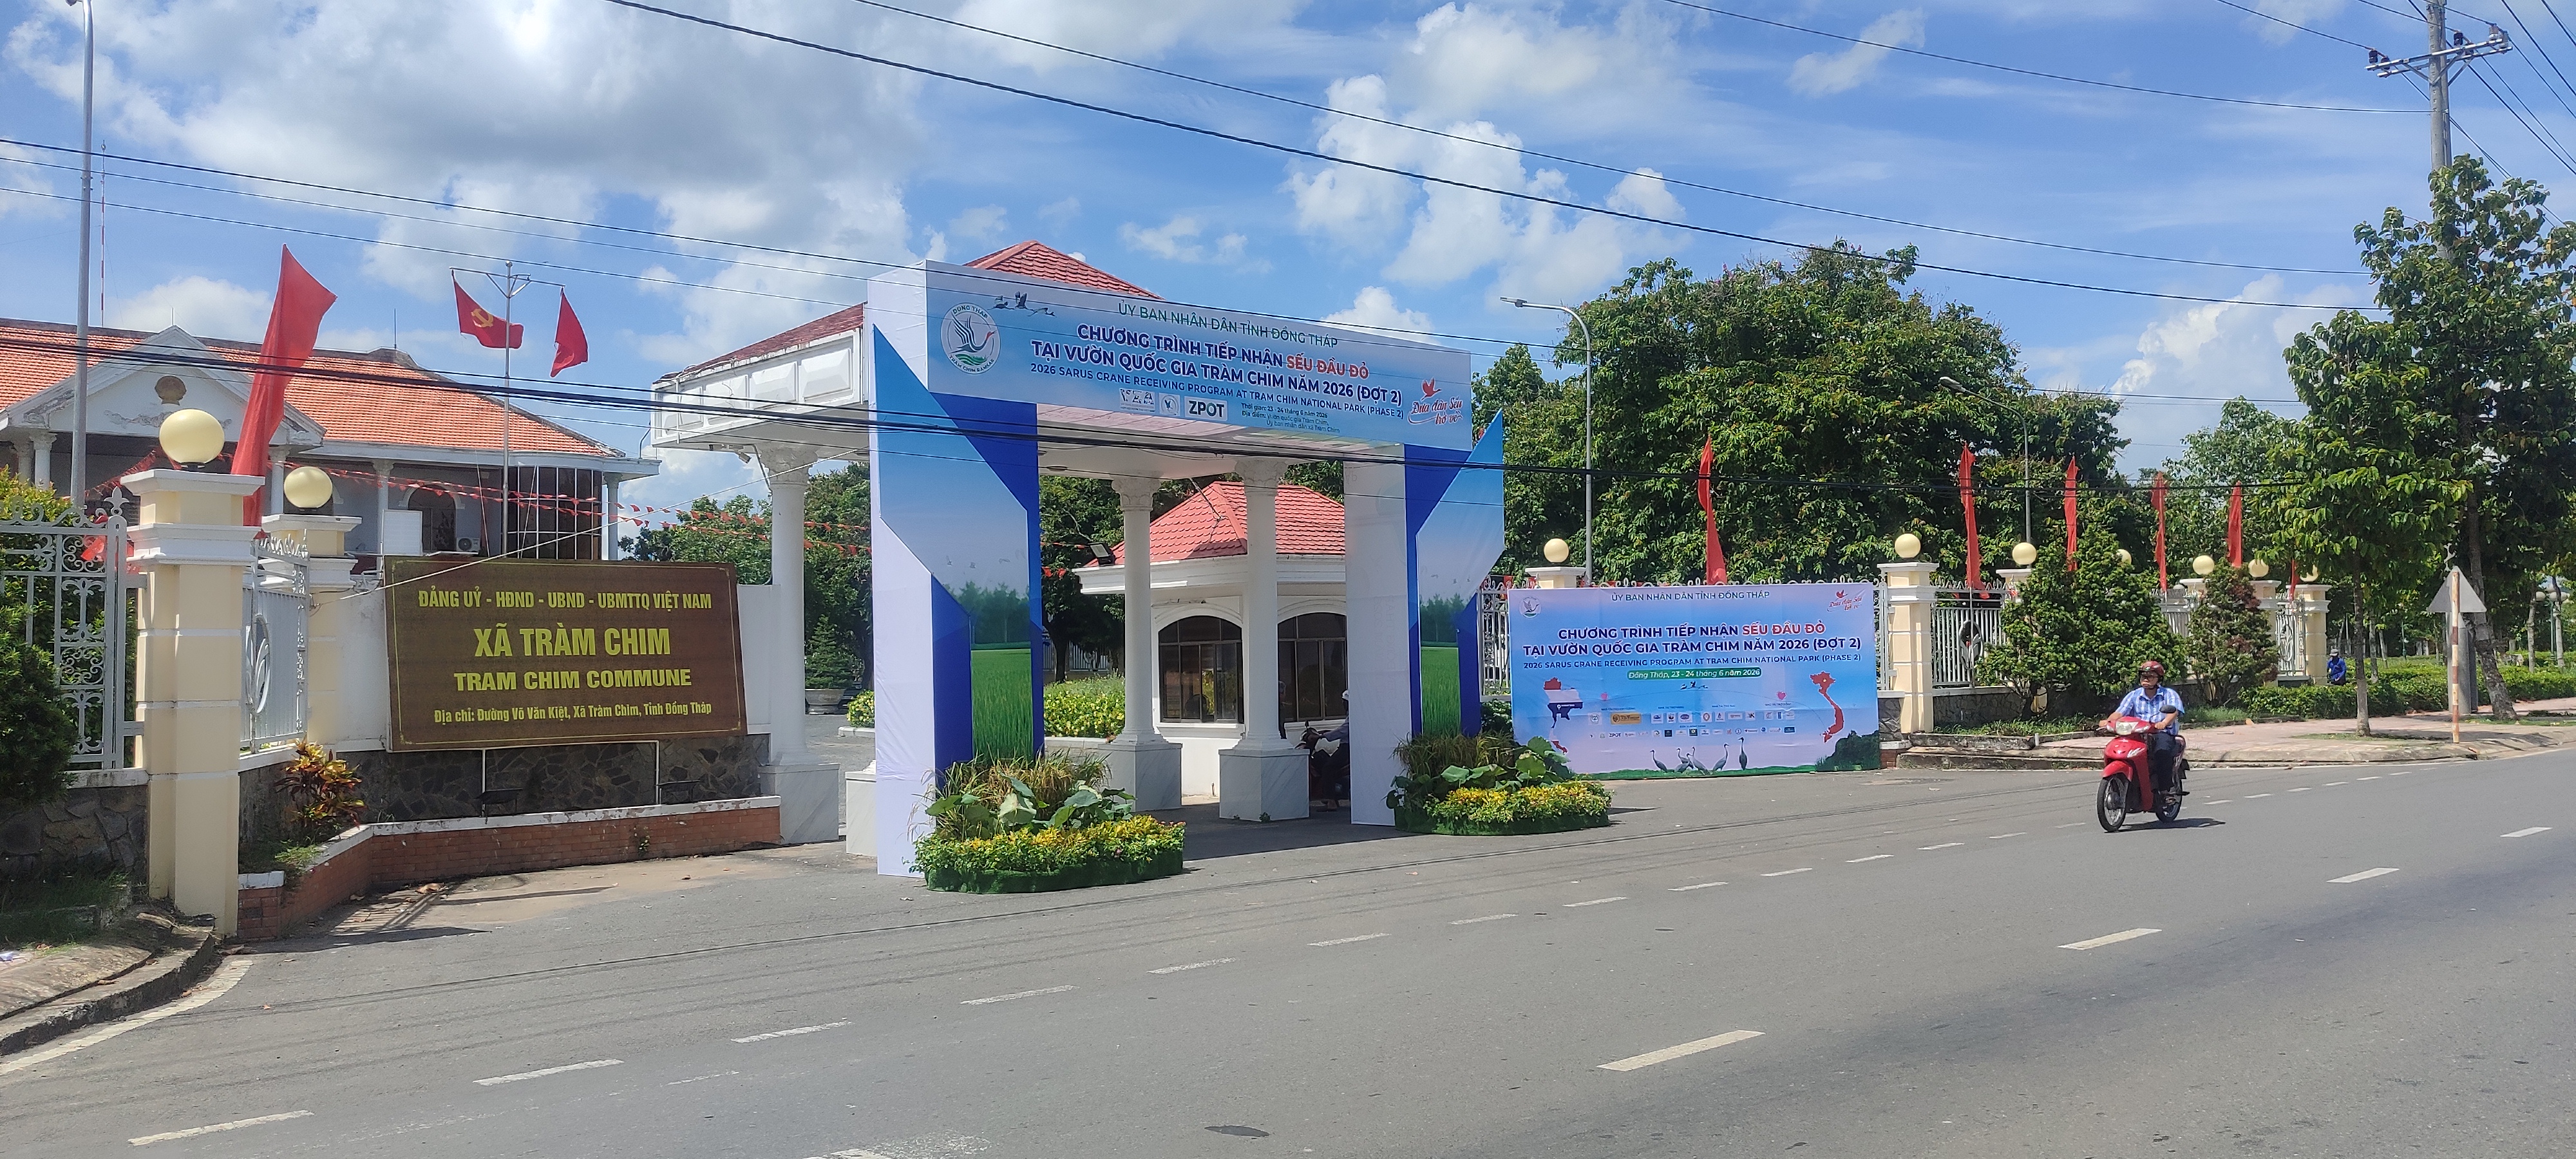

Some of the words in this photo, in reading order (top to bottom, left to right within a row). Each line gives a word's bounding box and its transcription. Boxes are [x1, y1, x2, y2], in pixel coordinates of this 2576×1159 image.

[1119, 299, 1135, 316] ỦY
[1141, 307, 1166, 322] BAN
[1171, 312, 1207, 328] NHÂN
[1211, 317, 1236, 333] DÂN
[1240, 320, 1267, 338] TỈNH
[1271, 326, 1305, 343] ĐỒNG
[1309, 334, 1338, 348] THÁP
[1077, 325, 1149, 348] CHƯƠNG
[1153, 334, 1200, 355] TRÌNH
[1205, 341, 1236, 360] TIẾP
[1242, 348, 1282, 369] NHẬN
[1287, 353, 1312, 371] SẾU
[1317, 357, 1345, 376] ĐẦU
[1349, 362, 1368, 379] ĐỎ
[1032, 341, 1059, 361] TẠI
[1064, 344, 1114, 366] VƯỜN
[1119, 352, 1166, 373] QUỐC
[1171, 361, 1197, 377] GIA
[1201, 363, 1243, 382] TRÀM
[1247, 371, 1283, 387] CHIM
[1289, 374, 1319, 393] NĂM
[1323, 381, 1353, 397] 2026
[1358, 385, 1387, 404] (ĐỢT
[1391, 391, 1401, 406] 2)
[1031, 363, 1056, 374] 2026
[1059, 367, 1094, 379] SARUS
[1097, 372, 1131, 384] CRANE
[1133, 376, 1185, 391] RECEIVING
[1188, 383, 1233, 397] PROGRAM
[1236, 390, 1247, 398] AT
[1249, 391, 1273, 402] TRAM
[1276, 395, 1298, 405] CHIM
[1301, 399, 1341, 410] NATIONAL
[1345, 403, 1365, 413] PARK
[1368, 407, 1395, 417] (PHASE
[1396, 410, 1403, 419] 2)
[1189, 400, 1224, 417] ZPOT
[418, 586, 459, 608] ĐẢNG
[464, 587, 481, 608] UỶ
[496, 592, 534, 608] HĐND
[548, 592, 585, 608] UBND
[598, 592, 649, 610] UBMTTQ
[654, 590, 679, 613] VIỆT
[683, 594, 711, 609] NAM
[1696, 590, 1716, 599] TỈNH
[1718, 590, 1744, 599] ĐỒNG
[1747, 590, 1769, 598] THÁP
[474, 623, 513, 657] XÃ
[520, 623, 596, 657] TRÀM
[605, 628, 670, 655] CHIM
[1558, 627, 1617, 639] CHƯƠNG
[1621, 625, 1662, 637] TRÌNH
[1666, 623, 1696, 637] TIẾP
[1700, 623, 1738, 638] NHẬN
[1743, 621, 1767, 635] SẾU
[1772, 621, 1800, 634] ĐẦU
[1804, 619, 1825, 633] ĐỎ
[1523, 645, 1544, 658] TẠI
[1548, 643, 1587, 655] VƯỜN
[1592, 640, 1631, 655] QUỐC
[1636, 643, 1659, 653] GIA
[1662, 641, 1701, 652] TRÀM
[1705, 641, 1739, 652] CHIM
[1744, 637, 1774, 650] NĂM
[1779, 639, 1809, 650] 2026
[1814, 637, 1845, 651] (ĐỢT
[1850, 637, 1861, 650] 2)
[1823, 654, 1852, 663] (PHASE
[1853, 654, 1861, 662] 2)
[454, 672, 516, 691] TRAM
[524, 671, 580, 690] CHIM
[587, 668, 692, 688] COMMUNE
[435, 710, 451, 725] Địa
[455, 708, 475, 722] chỉ:
[477, 708, 509, 722] Đường
[512, 707, 524, 720] Võ
[527, 706, 545, 719] Văn
[549, 706, 571, 721] Kiệt,
[573, 705, 586, 718] Xã
[589, 705, 612, 717] Tràm
[615, 704, 641, 717] Chim,
[644, 701, 663, 715] Tỉnh
[666, 701, 688, 715] Đồng
[690, 701, 712, 714] Tháp
